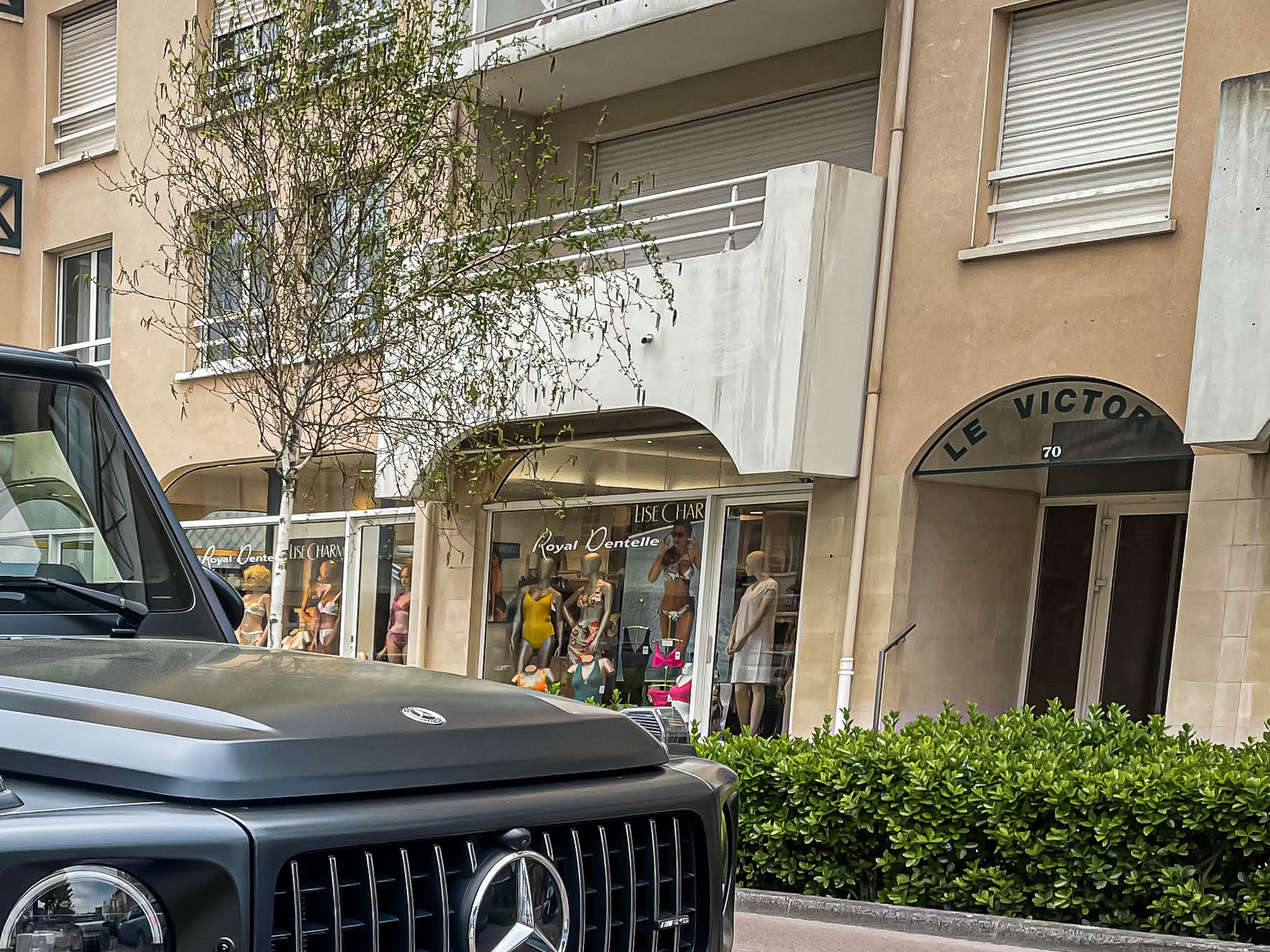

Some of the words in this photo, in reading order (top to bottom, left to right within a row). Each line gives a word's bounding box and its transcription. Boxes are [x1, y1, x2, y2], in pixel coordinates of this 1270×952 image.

[943, 417, 988, 462] LE
[1013, 388, 1173, 446] VICTORY
[1042, 445, 1062, 459] 70
[634, 503, 660, 523] LISE
[289, 543, 306, 560] LISE
[532, 530, 579, 560] Royal
[585, 526, 660, 552] Dentelle
[201, 544, 232, 569] Royal
